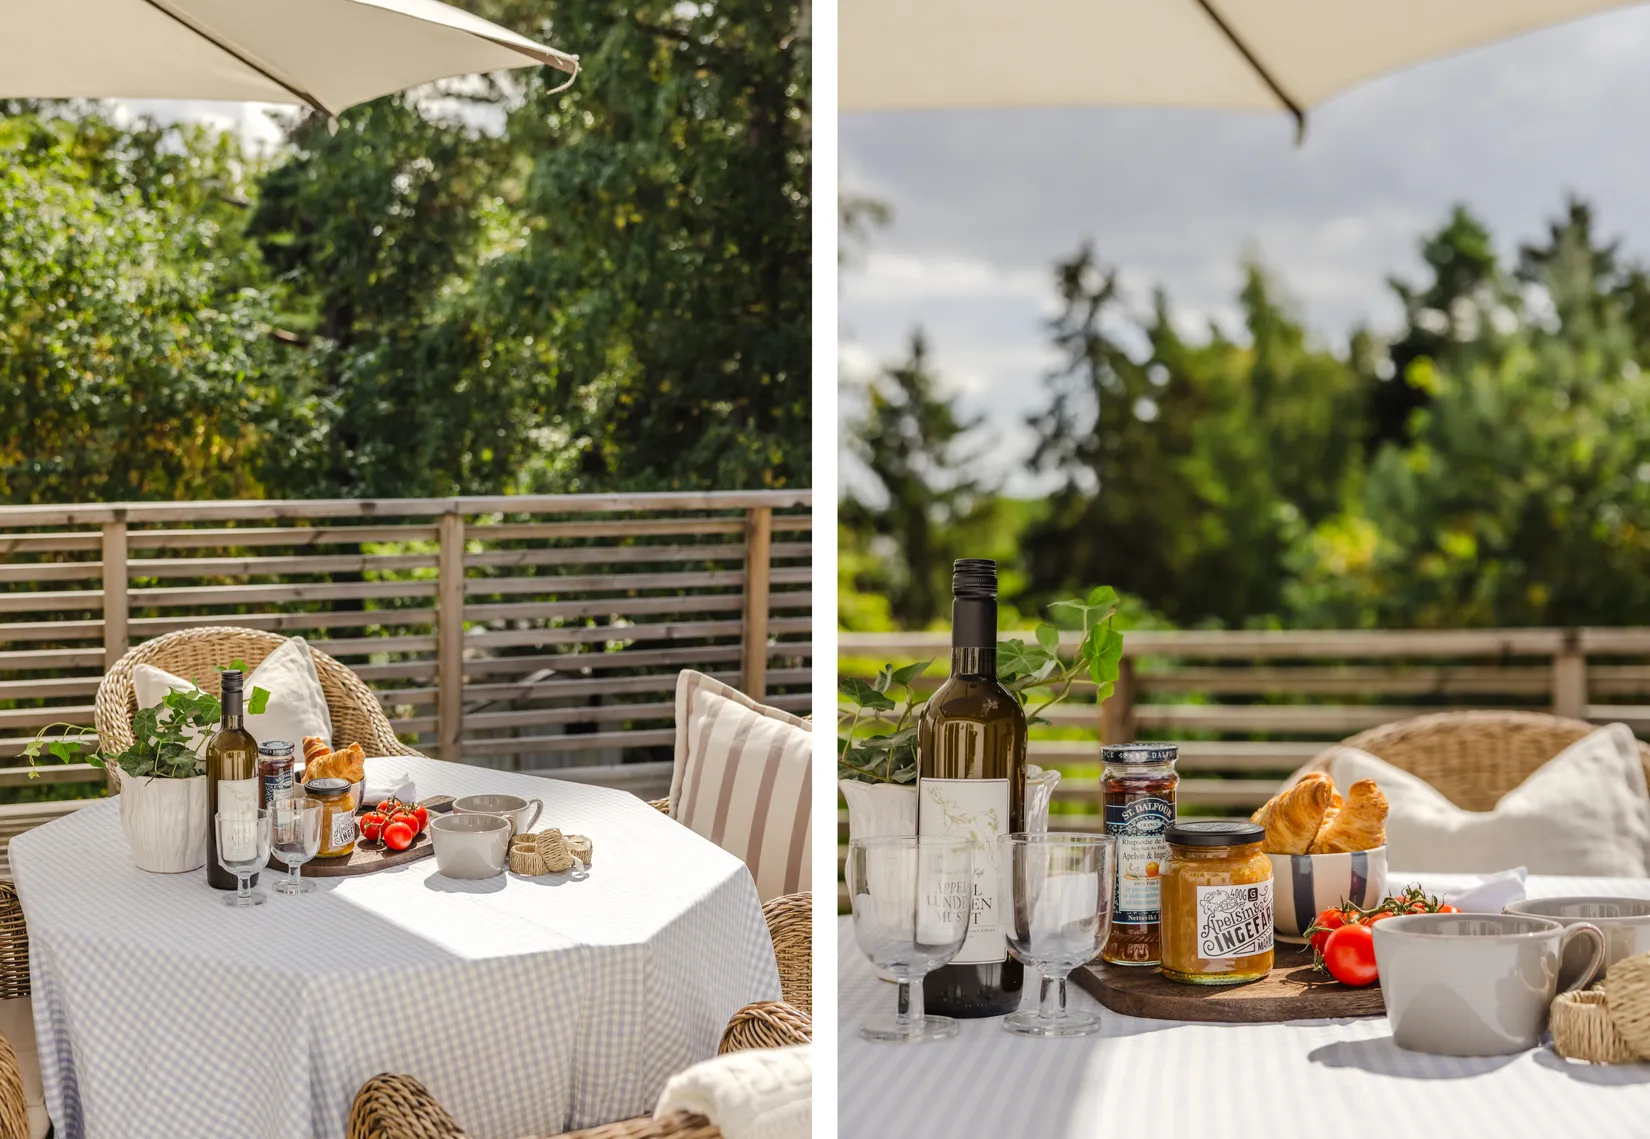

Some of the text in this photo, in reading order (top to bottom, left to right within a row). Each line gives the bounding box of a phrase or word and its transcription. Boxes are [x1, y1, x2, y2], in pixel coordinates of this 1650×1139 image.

[1121, 802, 1173, 820] ST. DALFOUR
[1121, 838, 1154, 847] Rhapsodie
[1121, 851, 1146, 862] Apelsin
[1146, 850, 1153, 860] &
[1127, 913, 1158, 921] Nettovikt
